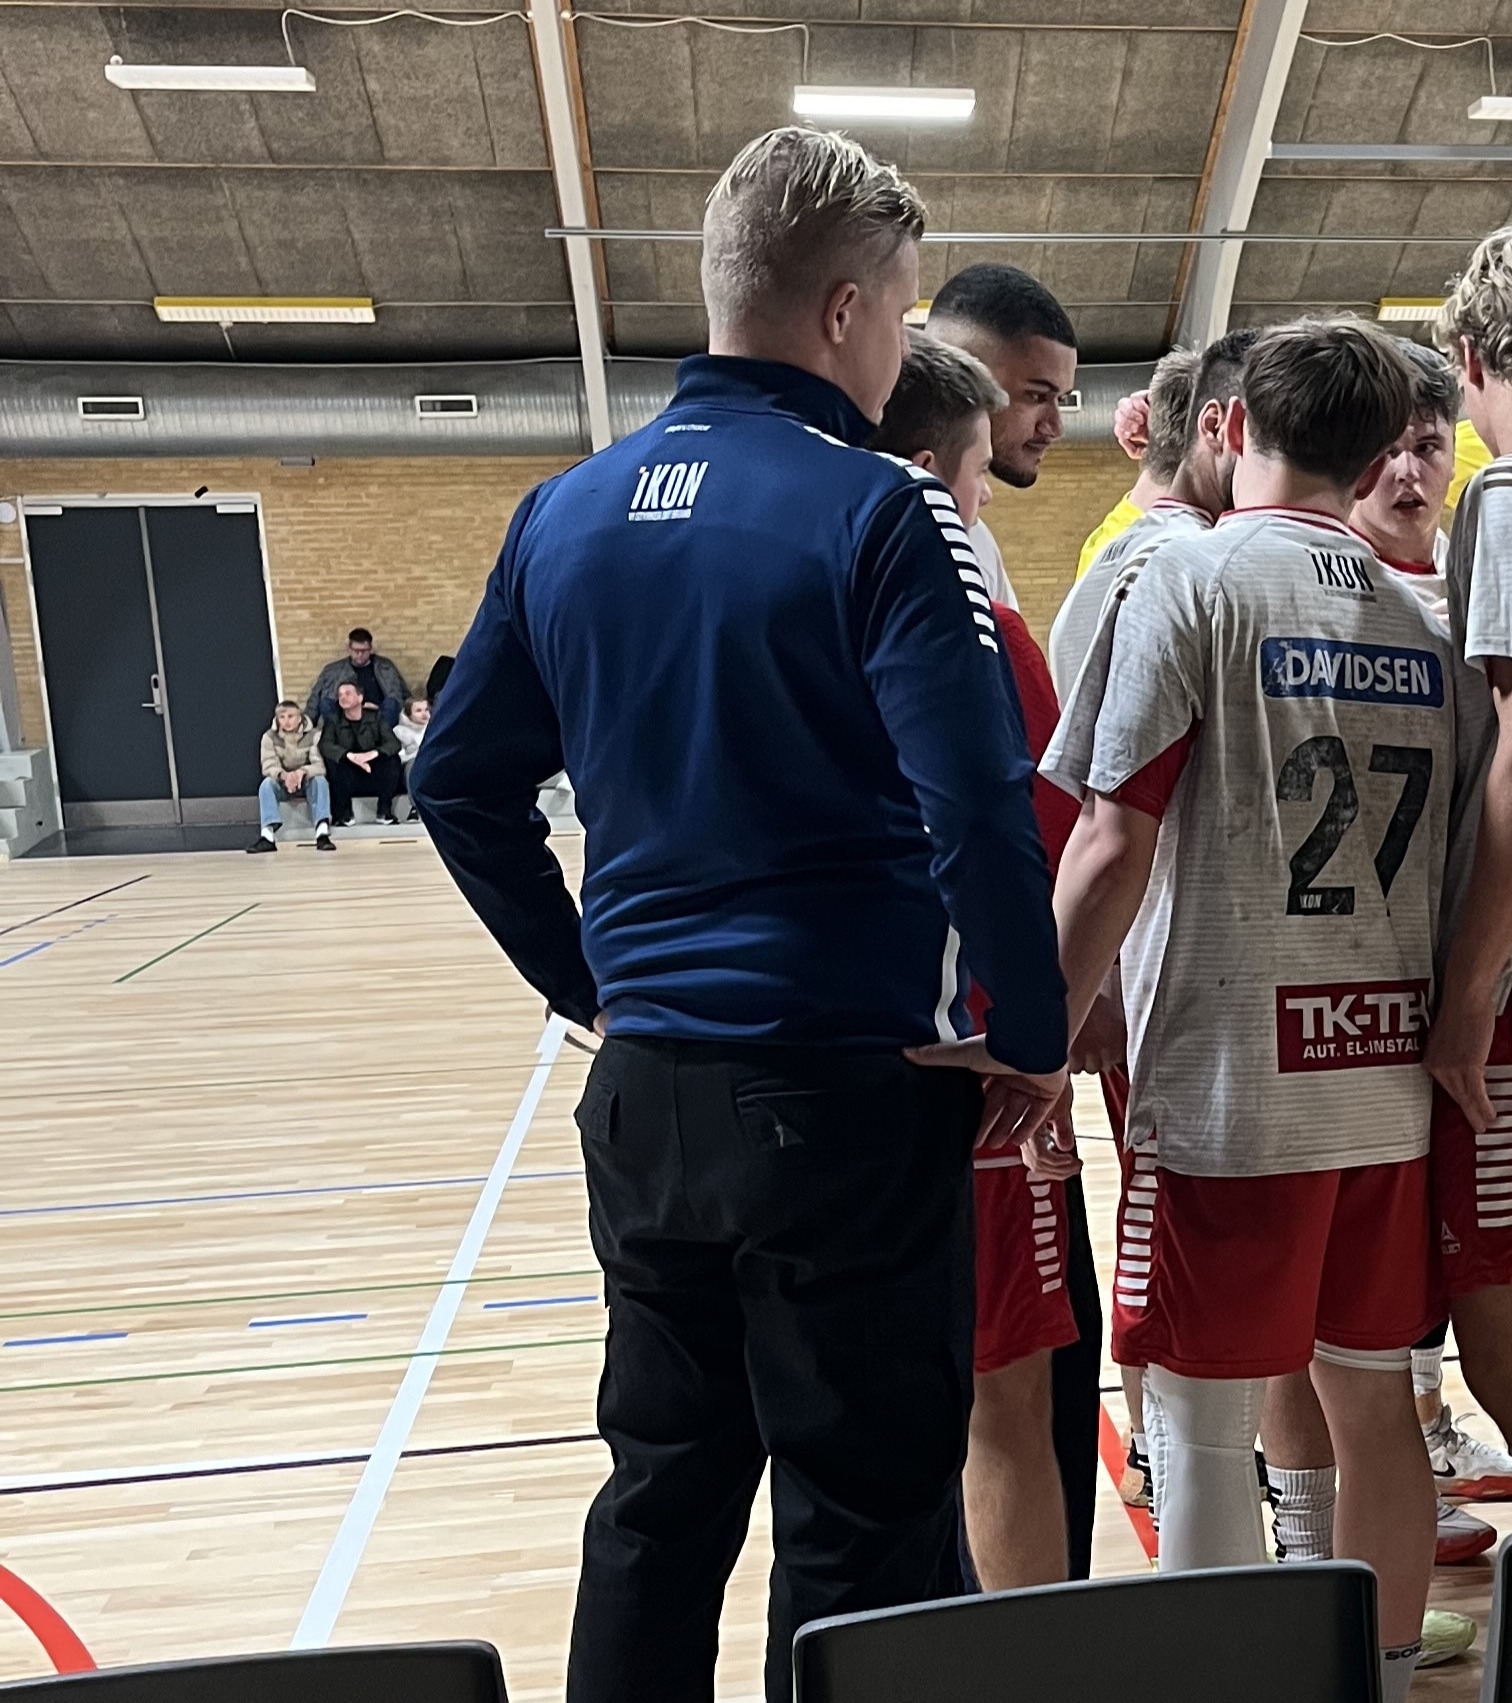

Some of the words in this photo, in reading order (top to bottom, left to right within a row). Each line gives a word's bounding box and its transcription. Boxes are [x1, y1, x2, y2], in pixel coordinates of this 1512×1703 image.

[1285, 648, 1431, 696] DAVIDSEN
[1276, 736, 1433, 917] 27
[1303, 1043, 1341, 1059] AUT.
[1346, 1038, 1420, 1056] EL-INSTAL
